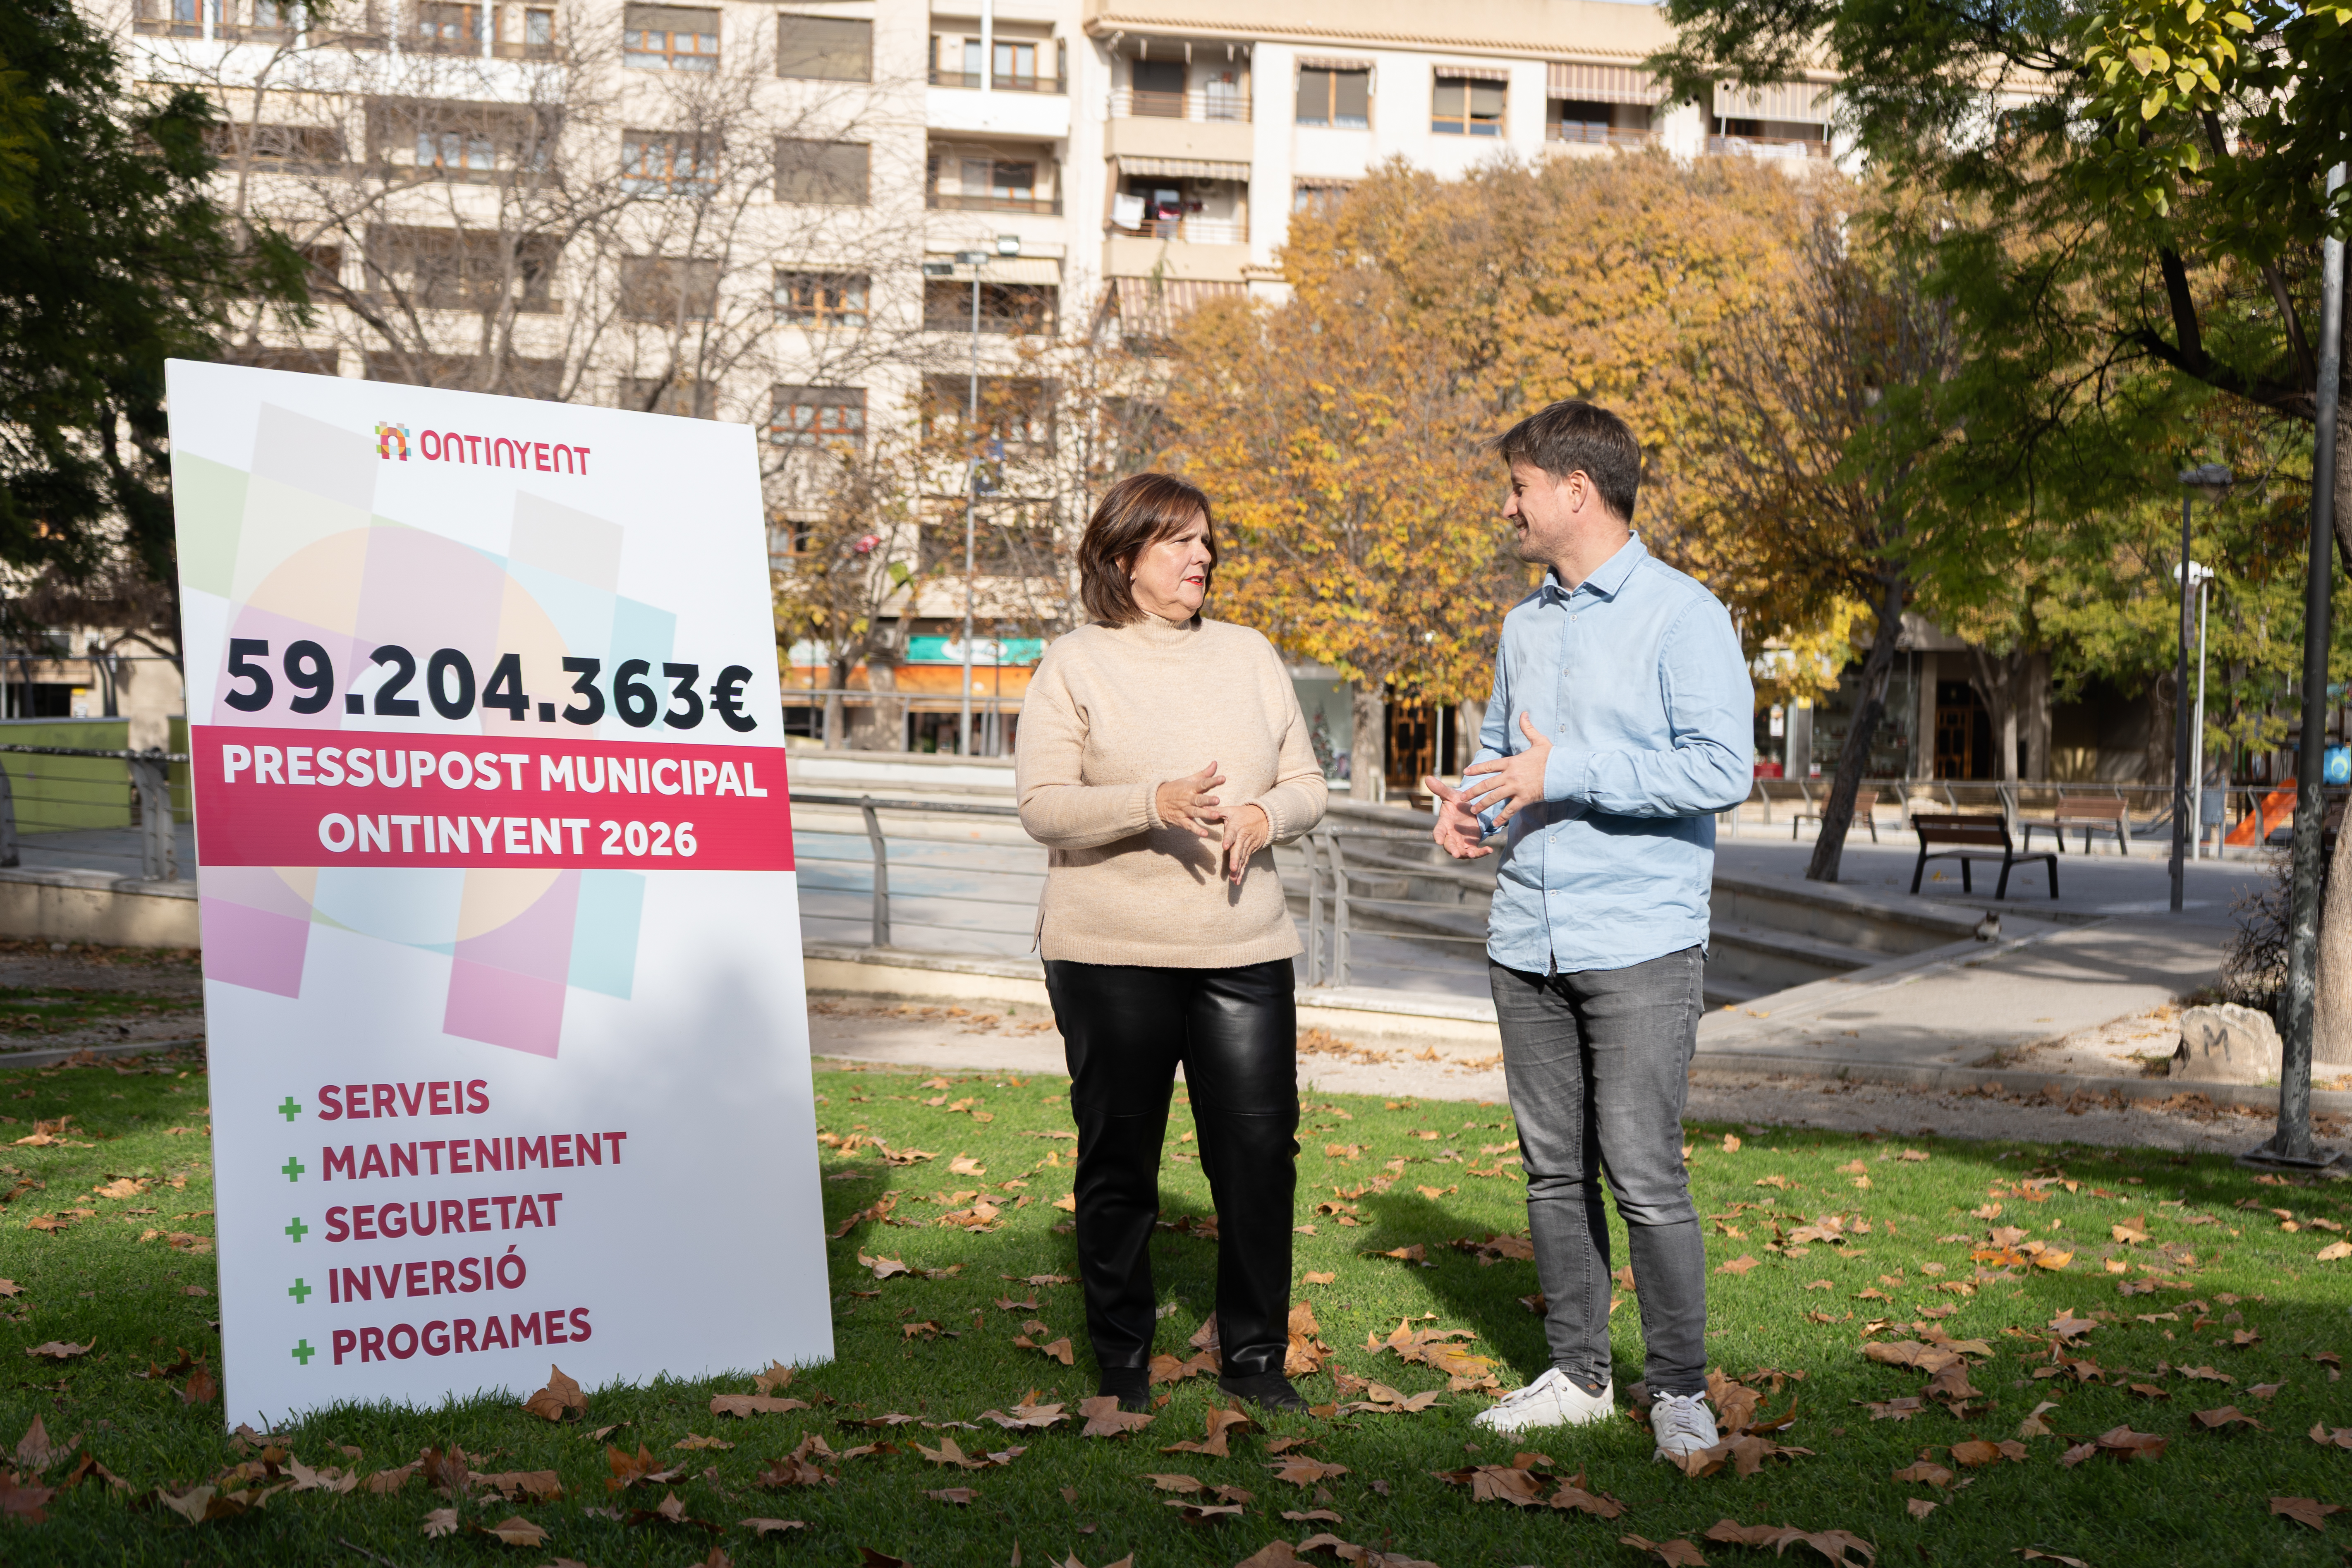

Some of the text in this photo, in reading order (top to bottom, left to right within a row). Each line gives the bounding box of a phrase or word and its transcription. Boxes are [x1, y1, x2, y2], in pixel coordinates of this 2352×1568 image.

[420, 429, 591, 476] ONTINYENT
[224, 638, 758, 733] 59.204.363€
[222, 744, 768, 797] PRESSUPOST MUNICIPAL
[318, 812, 698, 857] ONTINYENT 2026
[318, 1079, 490, 1121] SERVEIS
[323, 1132, 627, 1181] MANTENIMENT
[325, 1193, 562, 1243] SEGURETAT
[329, 1244, 526, 1303] INVERSIÓ
[333, 1307, 591, 1365] PROGRAMES
